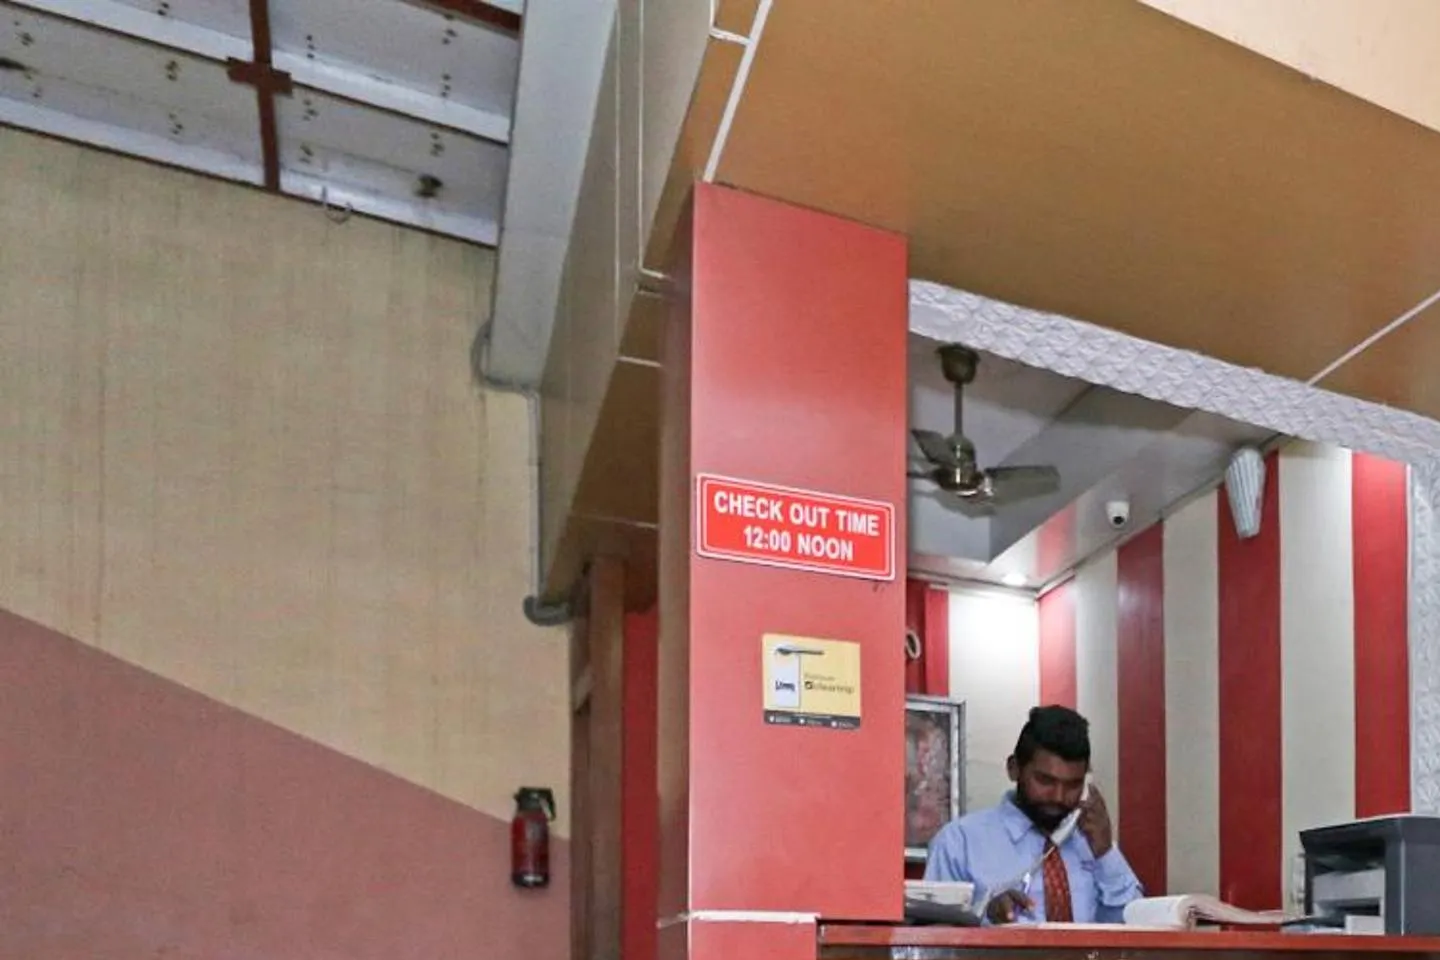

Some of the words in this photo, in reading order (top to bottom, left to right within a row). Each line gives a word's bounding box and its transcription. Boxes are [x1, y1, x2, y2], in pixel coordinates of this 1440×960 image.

[713, 491, 784, 522] CHECK
[789, 503, 830, 529] OUT
[835, 510, 880, 536] TIME
[743, 525, 791, 551] 12:00
[797, 533, 853, 561] NOON
